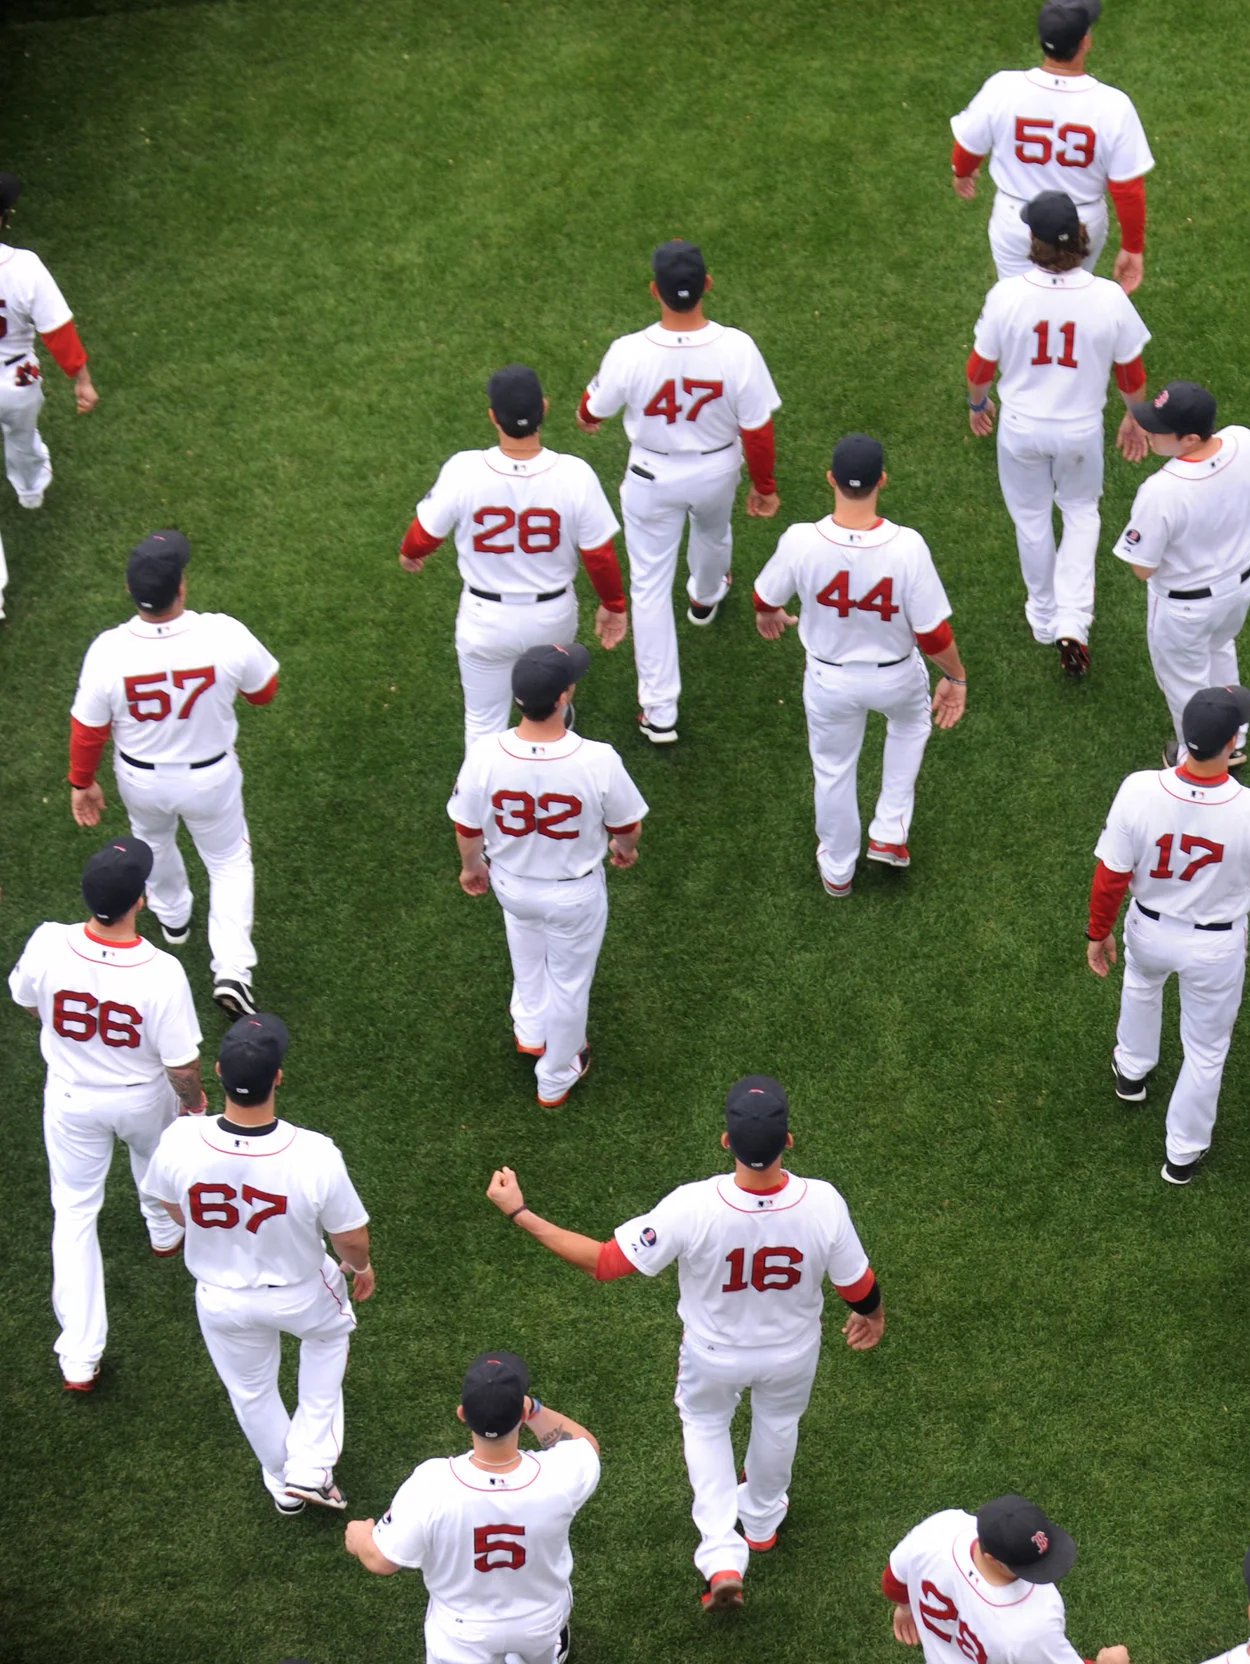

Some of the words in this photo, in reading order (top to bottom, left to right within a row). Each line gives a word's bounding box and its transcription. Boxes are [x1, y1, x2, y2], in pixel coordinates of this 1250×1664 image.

[1016, 117, 1096, 168] 53
[1032, 321, 1077, 368] 11
[645, 378, 723, 423] 47
[474, 507, 560, 553] 28
[817, 571, 898, 621] 44
[125, 666, 215, 721] 57
[492, 790, 582, 839] 32
[1151, 834, 1223, 880] 17
[54, 991, 142, 1047] 66
[189, 1183, 286, 1232] 67
[724, 1247, 802, 1291] 16
[475, 1525, 524, 1572] 5
[1031, 1531, 1049, 1554] B
